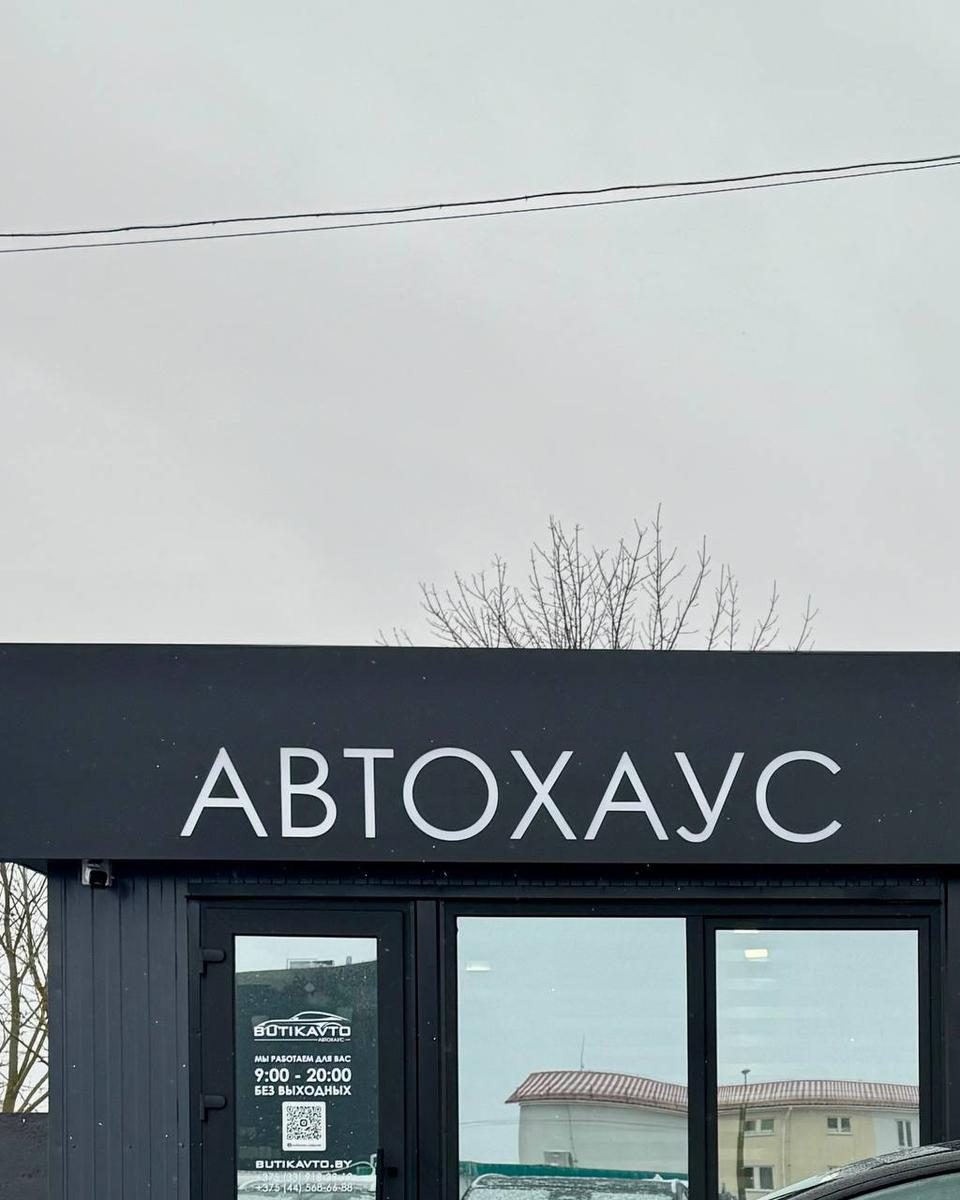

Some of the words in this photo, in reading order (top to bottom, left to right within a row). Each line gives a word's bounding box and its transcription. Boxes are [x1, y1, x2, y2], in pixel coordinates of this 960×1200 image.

[180, 746, 842, 844] АВТОХАУС
[253, 1026, 351, 1037] BUTIKAVTO
[254, 1055, 269, 1063] МЫ
[271, 1055, 314, 1063] РАБОТАЕМ
[315, 1055, 332, 1063] ДЛЯ
[334, 1055, 352, 1063] ВАС
[254, 1068, 290, 1082] 9:00
[306, 1068, 352, 1082] 20:00
[254, 1085, 275, 1096] БЕЗ
[278, 1085, 352, 1097] ВЫХОДНЫХ
[255, 1160, 352, 1169] BUTIKAVTO.BY
